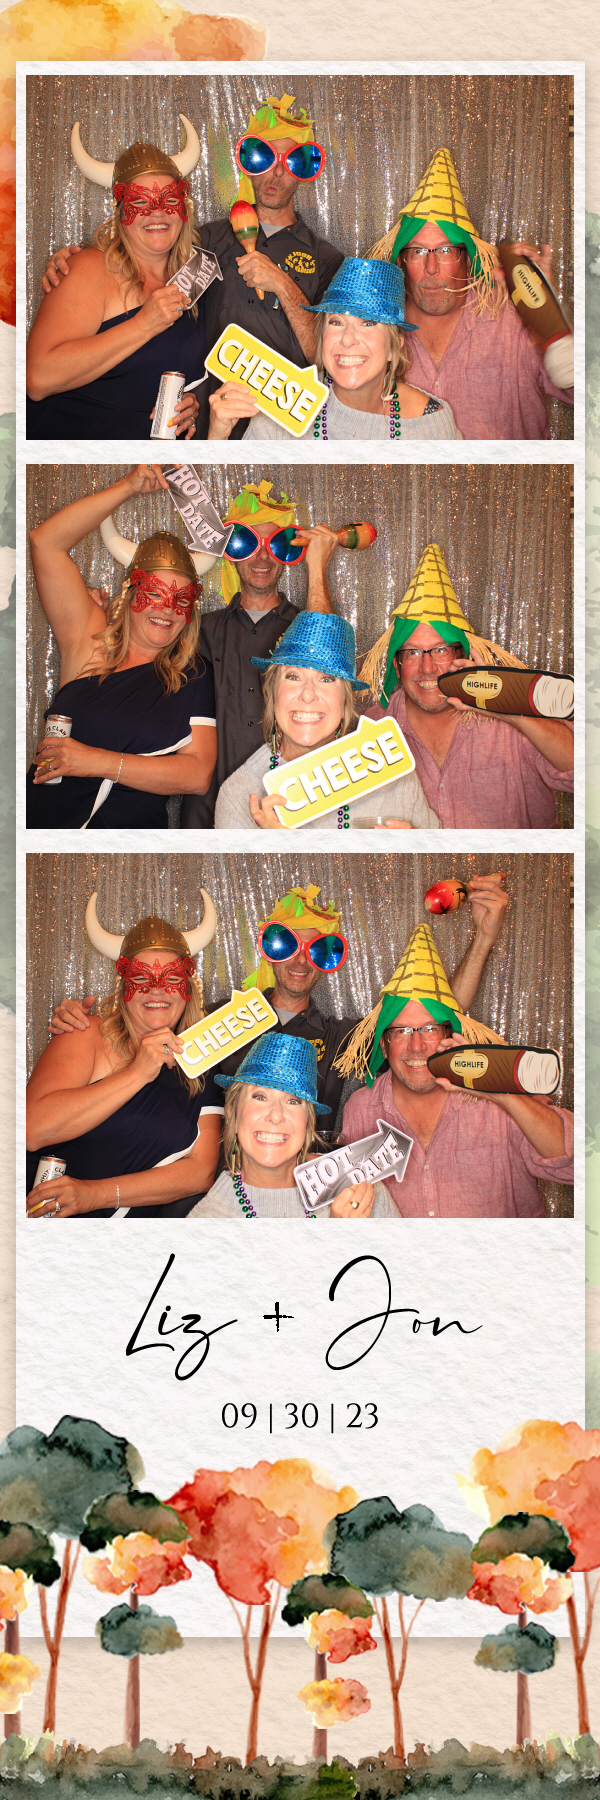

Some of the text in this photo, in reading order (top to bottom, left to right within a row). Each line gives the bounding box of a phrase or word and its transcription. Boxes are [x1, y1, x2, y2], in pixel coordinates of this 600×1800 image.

[195, 252, 217, 290] DATE
[517, 269, 540, 303] HIGHLIFE
[217, 339, 317, 423] CHEESE
[165, 464, 212, 508] HOT
[179, 503, 226, 550] DATE
[466, 680, 498, 690] HIGHLIFE
[278, 730, 404, 812] CHEESE
[180, 997, 269, 1065] CHEESE
[454, 1060, 484, 1069] HIGHLIFE
[298, 1146, 355, 1207] HOT
[347, 1130, 405, 1185] DATE
